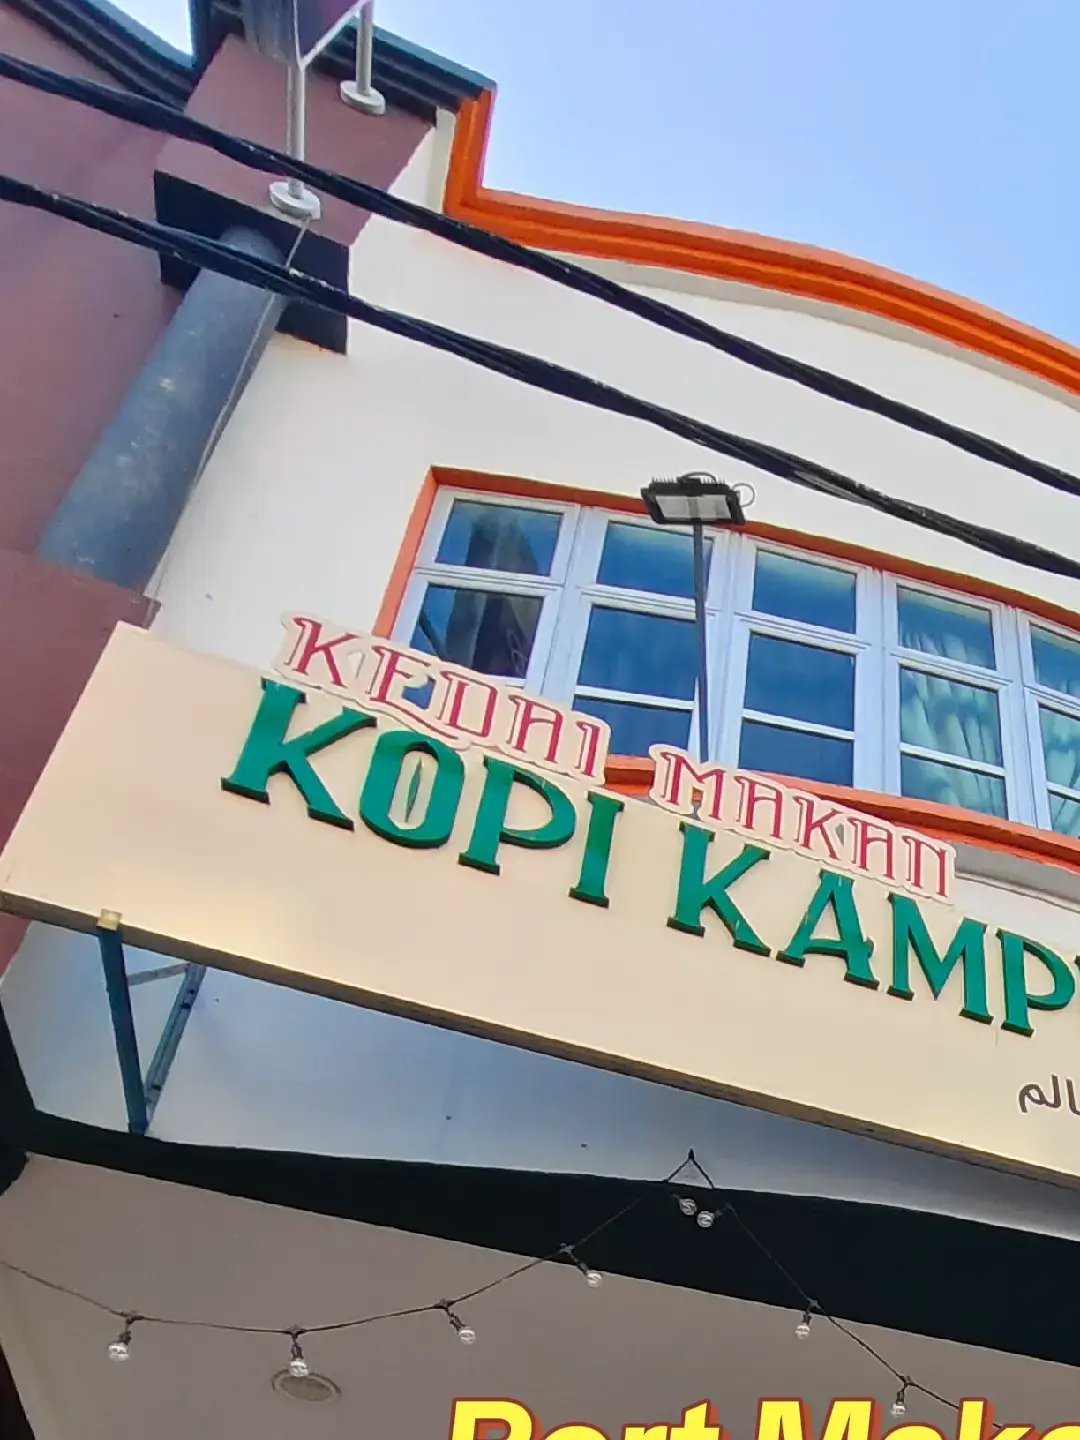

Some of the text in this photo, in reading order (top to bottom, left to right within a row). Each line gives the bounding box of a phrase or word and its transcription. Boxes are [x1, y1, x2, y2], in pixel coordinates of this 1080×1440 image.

[220, 677, 624, 908] KOPI
[289, 614, 949, 898] KEDAI MAKAN
